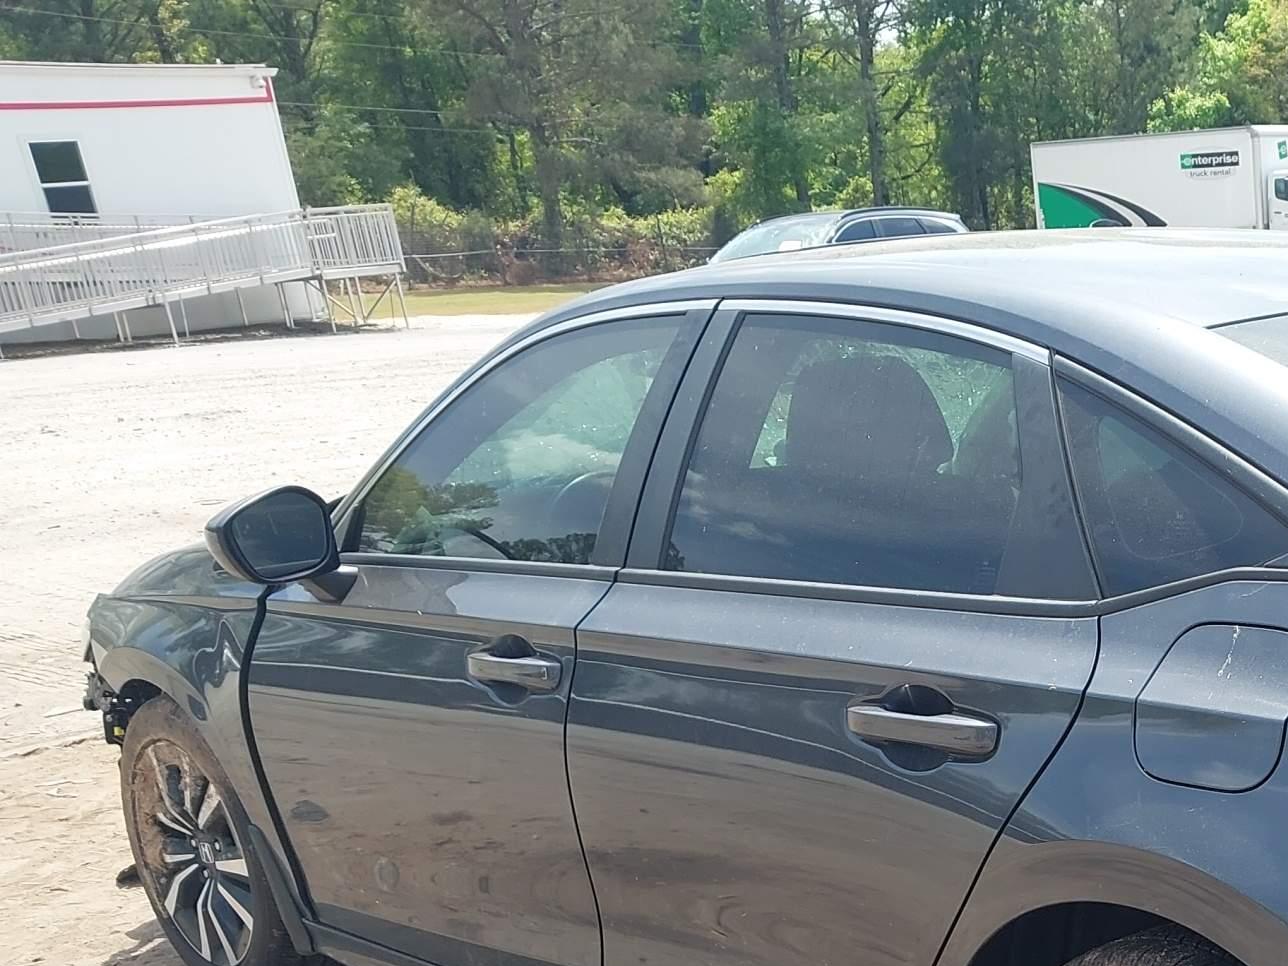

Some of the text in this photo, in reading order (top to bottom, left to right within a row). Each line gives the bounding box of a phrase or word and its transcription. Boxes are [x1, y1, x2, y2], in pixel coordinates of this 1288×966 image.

[1182, 153, 1239, 167] enterprise
[1190, 168, 1231, 178] truck rental
